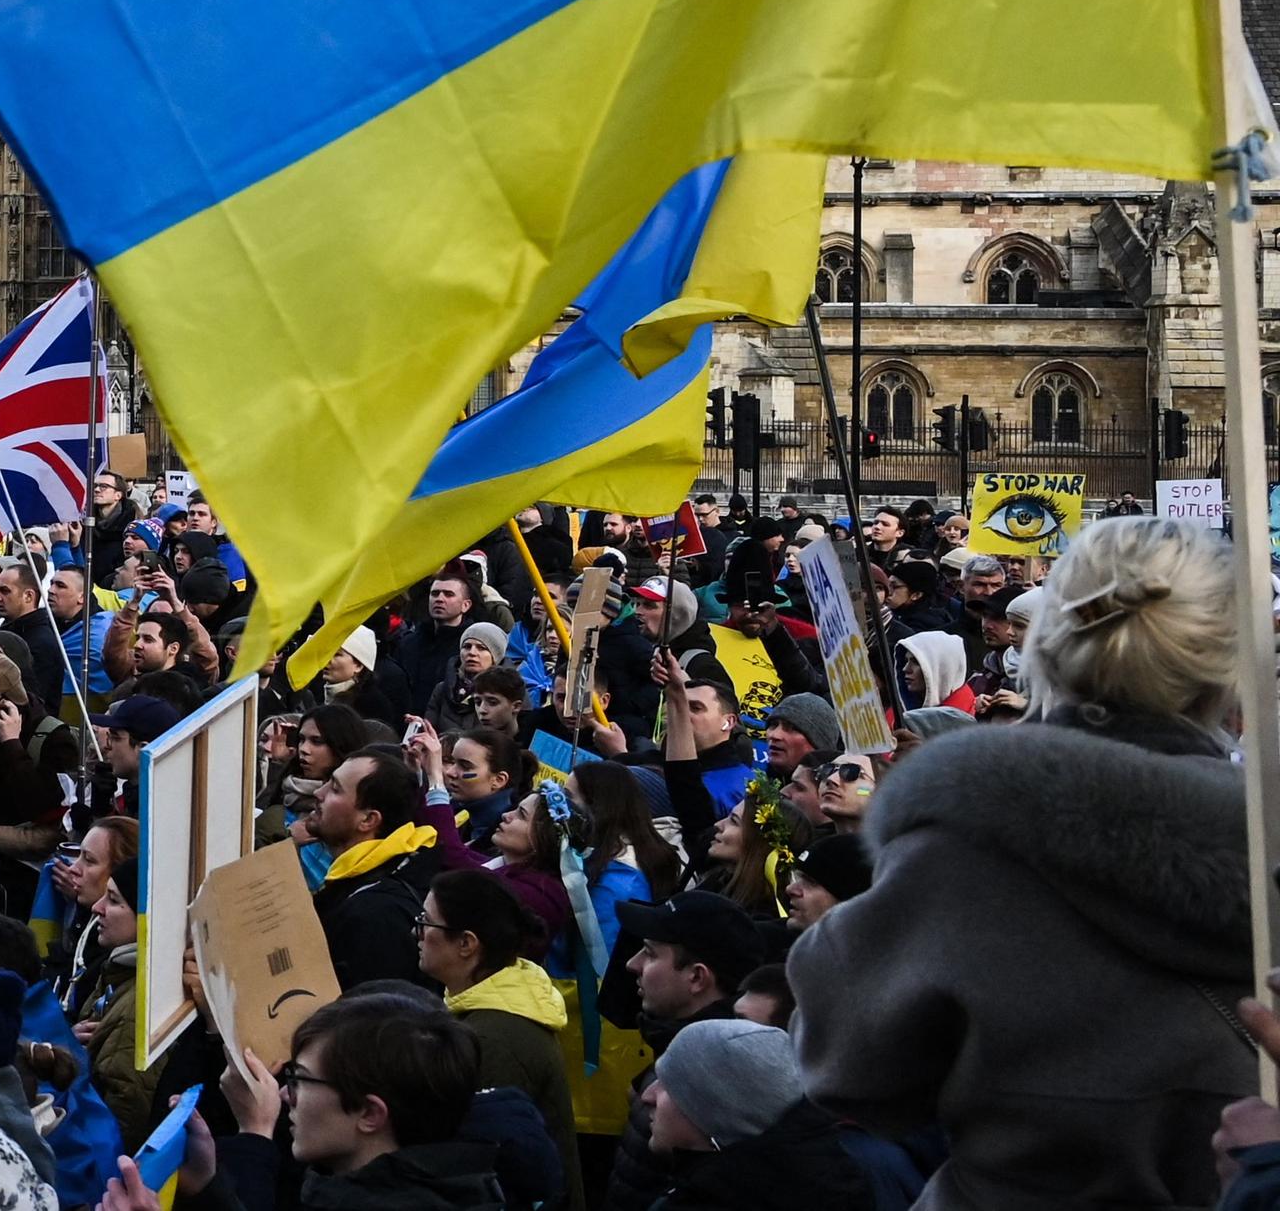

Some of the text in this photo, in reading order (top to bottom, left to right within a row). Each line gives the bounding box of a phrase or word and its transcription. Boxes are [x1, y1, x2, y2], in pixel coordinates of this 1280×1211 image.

[983, 473, 1083, 496] STOP WAR
[1171, 484, 1213, 498] STOP
[1167, 502, 1223, 518] PUTLER
